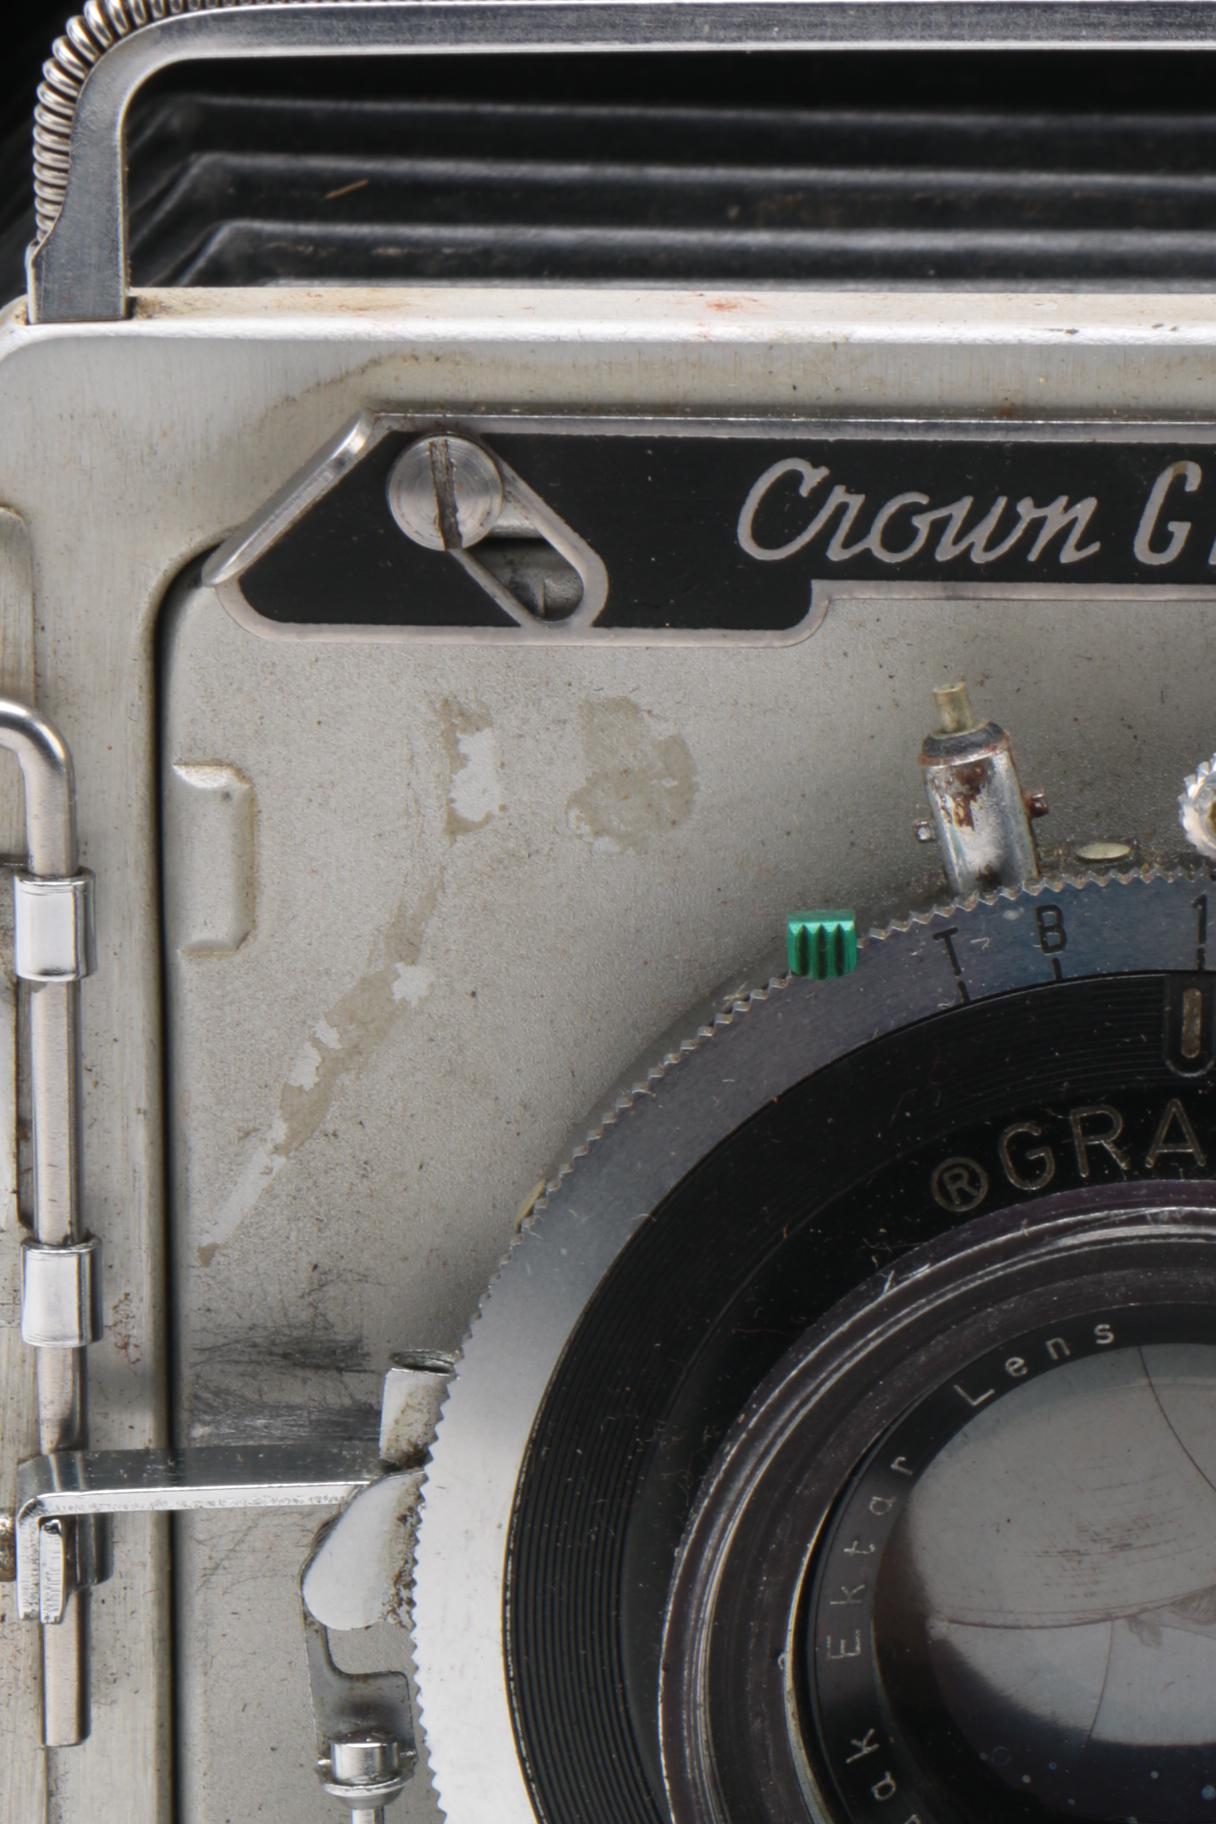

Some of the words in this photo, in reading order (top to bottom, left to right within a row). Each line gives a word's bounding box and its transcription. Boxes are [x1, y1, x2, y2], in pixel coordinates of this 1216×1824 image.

[737, 457, 1100, 563] Crown
[932, 926, 962, 977] T
[1034, 904, 1068, 955] B
[1191, 893, 1208, 946] 1
[825, 1453, 914, 1662] Ektar
[953, 1322, 1116, 1408] Lens
